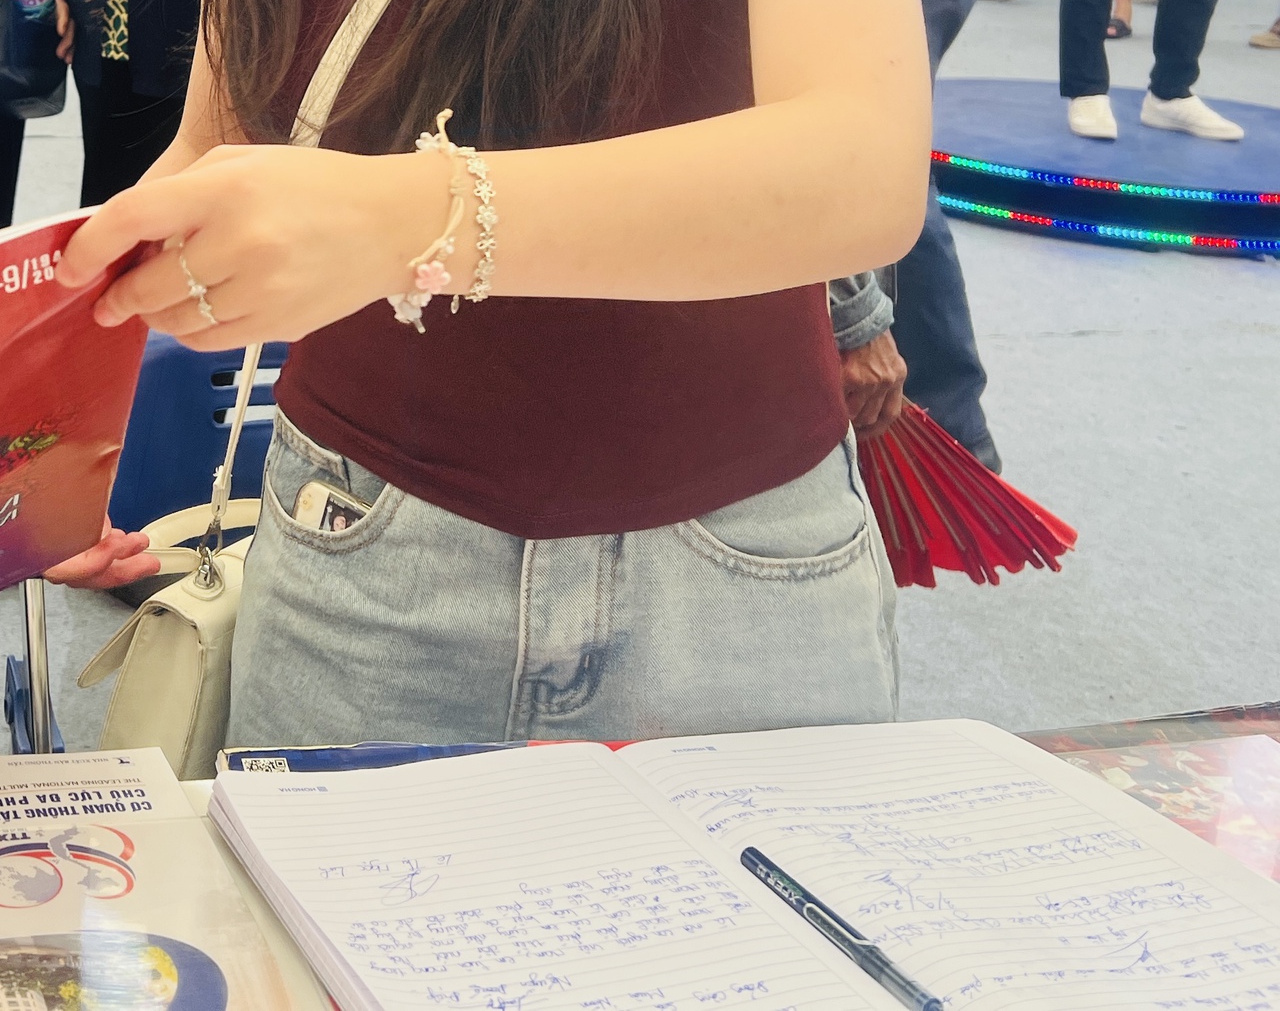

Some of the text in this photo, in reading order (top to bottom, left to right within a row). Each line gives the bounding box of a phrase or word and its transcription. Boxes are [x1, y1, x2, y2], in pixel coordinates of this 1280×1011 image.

[29, 780, 79, 788] NATIONAL
[80, 778, 122, 786] LEADING
[35, 793, 61, 804] ĐA
[67, 789, 103, 802] LỰC
[109, 789, 146, 801] CHỦ
[82, 802, 126, 815] QUAN
[130, 801, 152, 812] CƠ
[24, 806, 79, 819] THÔNG
